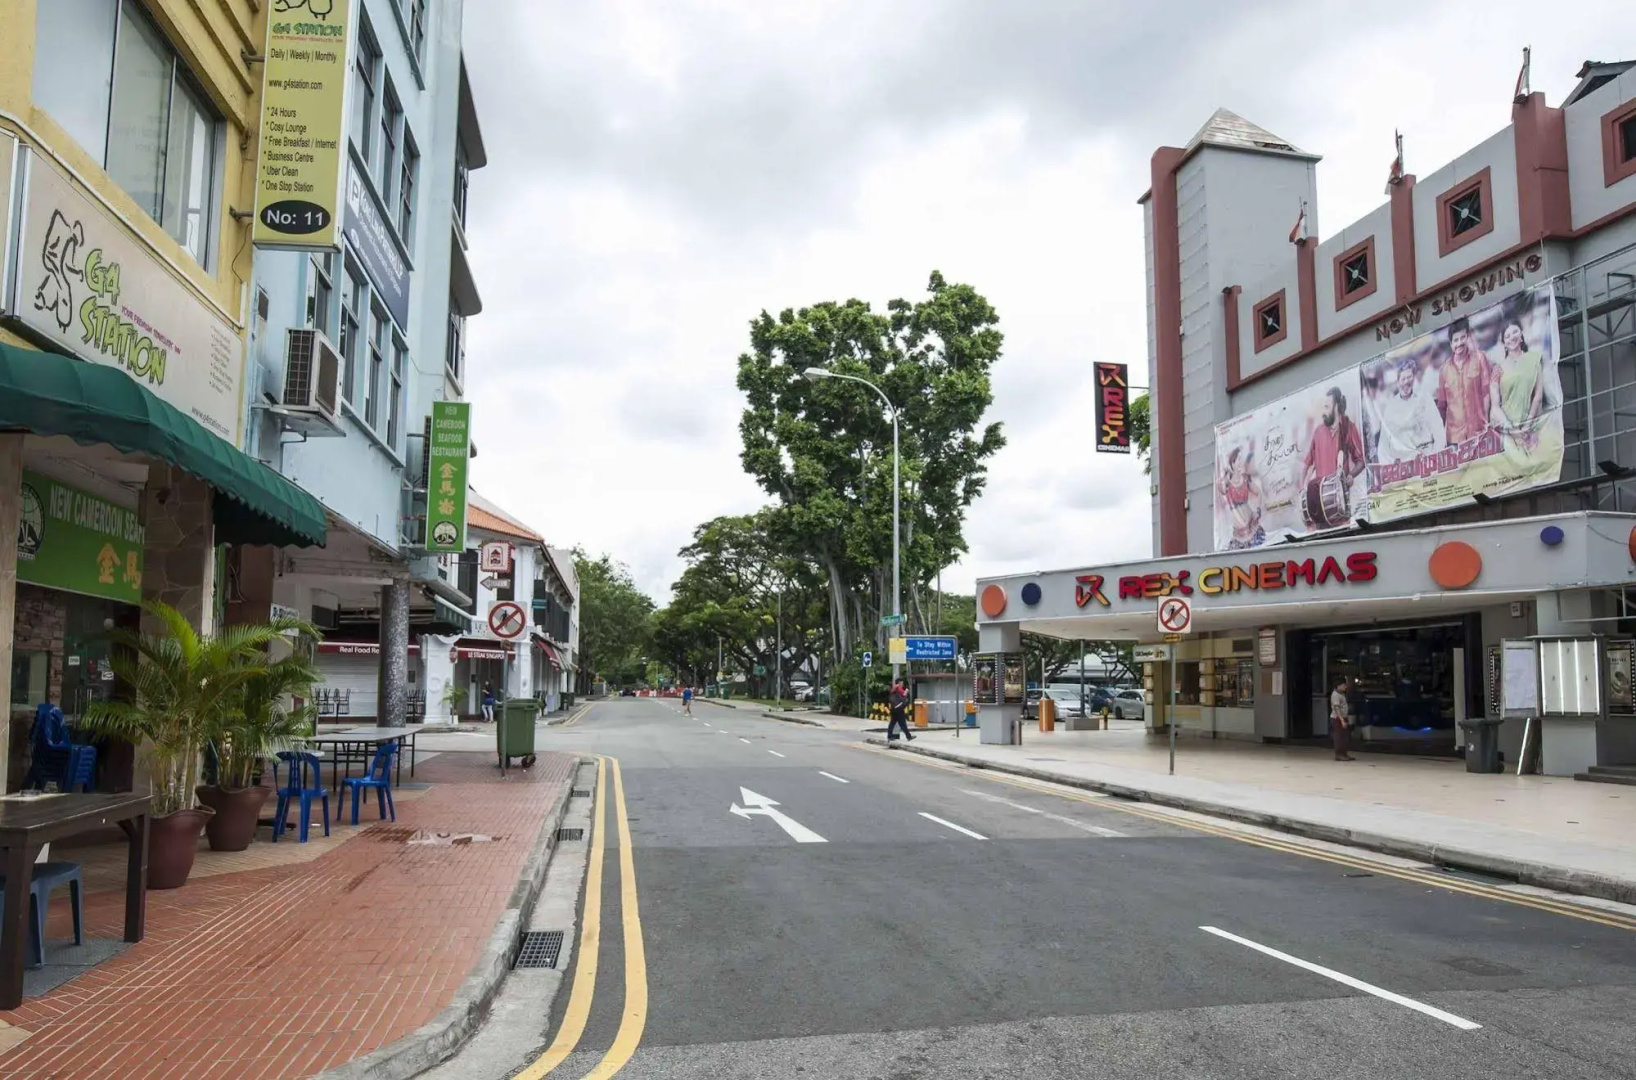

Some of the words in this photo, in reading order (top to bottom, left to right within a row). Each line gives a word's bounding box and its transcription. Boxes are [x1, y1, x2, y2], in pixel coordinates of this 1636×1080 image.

[293, 22, 343, 36] STATION
[271, 48, 286, 61] Daily
[290, 49, 311, 63] Weekly
[315, 50, 337, 64] Monthly
[268, 79, 323, 90] www.g4station.com
[270, 106, 278, 117] 24
[279, 107, 297, 118] Hours
[269, 121, 284, 134] Cosy
[285, 121, 307, 135] Lounge
[268, 136, 282, 146] Free
[283, 137, 310, 148] Breakfast
[315, 139, 337, 149] Internet
[267, 150, 294, 162] Business
[294, 152, 314, 163] Centre
[266, 165, 281, 176] Uber
[281, 166, 299, 177] Clean
[265, 180, 278, 190] One
[279, 181, 292, 193] Stop
[293, 181, 314, 192] Station
[266, 209, 296, 225] No:
[304, 211, 323, 226] 11
[84, 248, 120, 306] G4
[1376, 306, 1422, 342] NOW
[1430, 253, 1543, 316] SHOWING
[79, 295, 167, 386] STATION
[436, 419, 466, 430] CAMEROON
[437, 432, 463, 443] SEAFOOD
[431, 446, 466, 457] RESTAURANT
[50, 484, 73, 522] NEW
[74, 493, 123, 538] CAMEROON
[1118, 569, 1194, 600] REX
[1198, 551, 1378, 594] CINEMAS
[355, 646, 371, 654] Food
[923, 641, 935, 649] Stay
